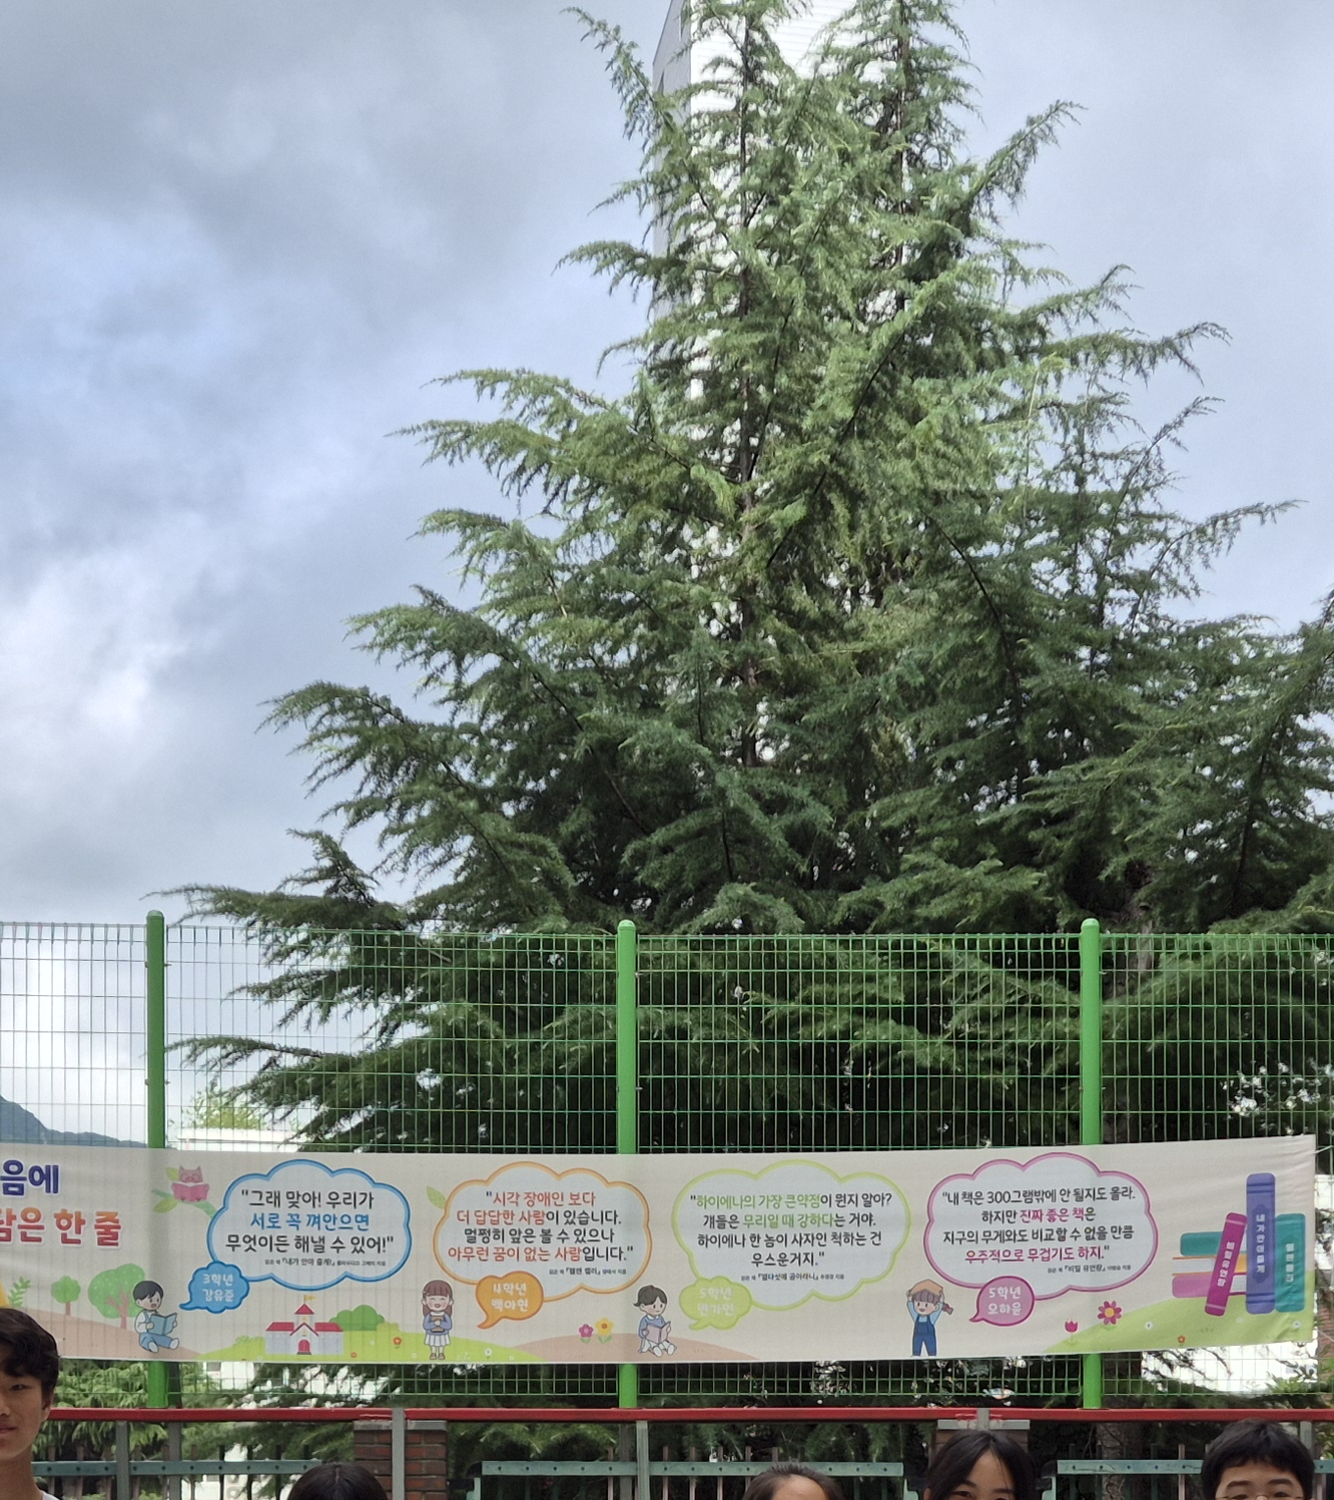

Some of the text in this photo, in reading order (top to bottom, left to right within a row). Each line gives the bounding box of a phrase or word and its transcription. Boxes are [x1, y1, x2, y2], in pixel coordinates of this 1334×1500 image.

[241, 1190, 374, 1209] "그래 맞아! 우리가
[486, 1190, 596, 1207] "시각 장애인 보다
[690, 1194, 756, 1209] "하이에나의
[759, 1195, 782, 1209] 가장
[835, 1193, 859, 1208] 뭔지
[862, 1193, 892, 1207] 알아?
[942, 1186, 1135, 1206] "내 책은 300그램밖에 안 될지도 몰라.
[251, 1213, 370, 1231] 서로 꼭 껴안으면
[457, 1210, 622, 1226] 더 답답한 사람이 있습니다.
[703, 1212, 876, 1229] 걔들은 무리일 때 강하다는 거야.
[981, 1207, 1096, 1225] 하지만 진짜 좋은 책은
[54, 1208, 86, 1244] 한
[94, 1211, 122, 1247] 줄
[464, 1228, 614, 1244] 멀쩡히 앞은 볼 수 있으나
[943, 1225, 1135, 1245] 지구의 무게와도 비교할 수 없을 만큼
[226, 1235, 394, 1254] 무엇이든 해낼 수 있어!"
[697, 1231, 882, 1249] 하이에나 한 놈이 사자인 척하는 건
[448, 1246, 633, 1262] 아무런 꿈이 없는 사람입니다."
[751, 1252, 825, 1267] 우스운거지."
[965, 1245, 1110, 1264] 우주적으로 무겁기도 하지."
[203, 1274, 234, 1287] 3학년
[989, 1286, 1021, 1300] 5학년
